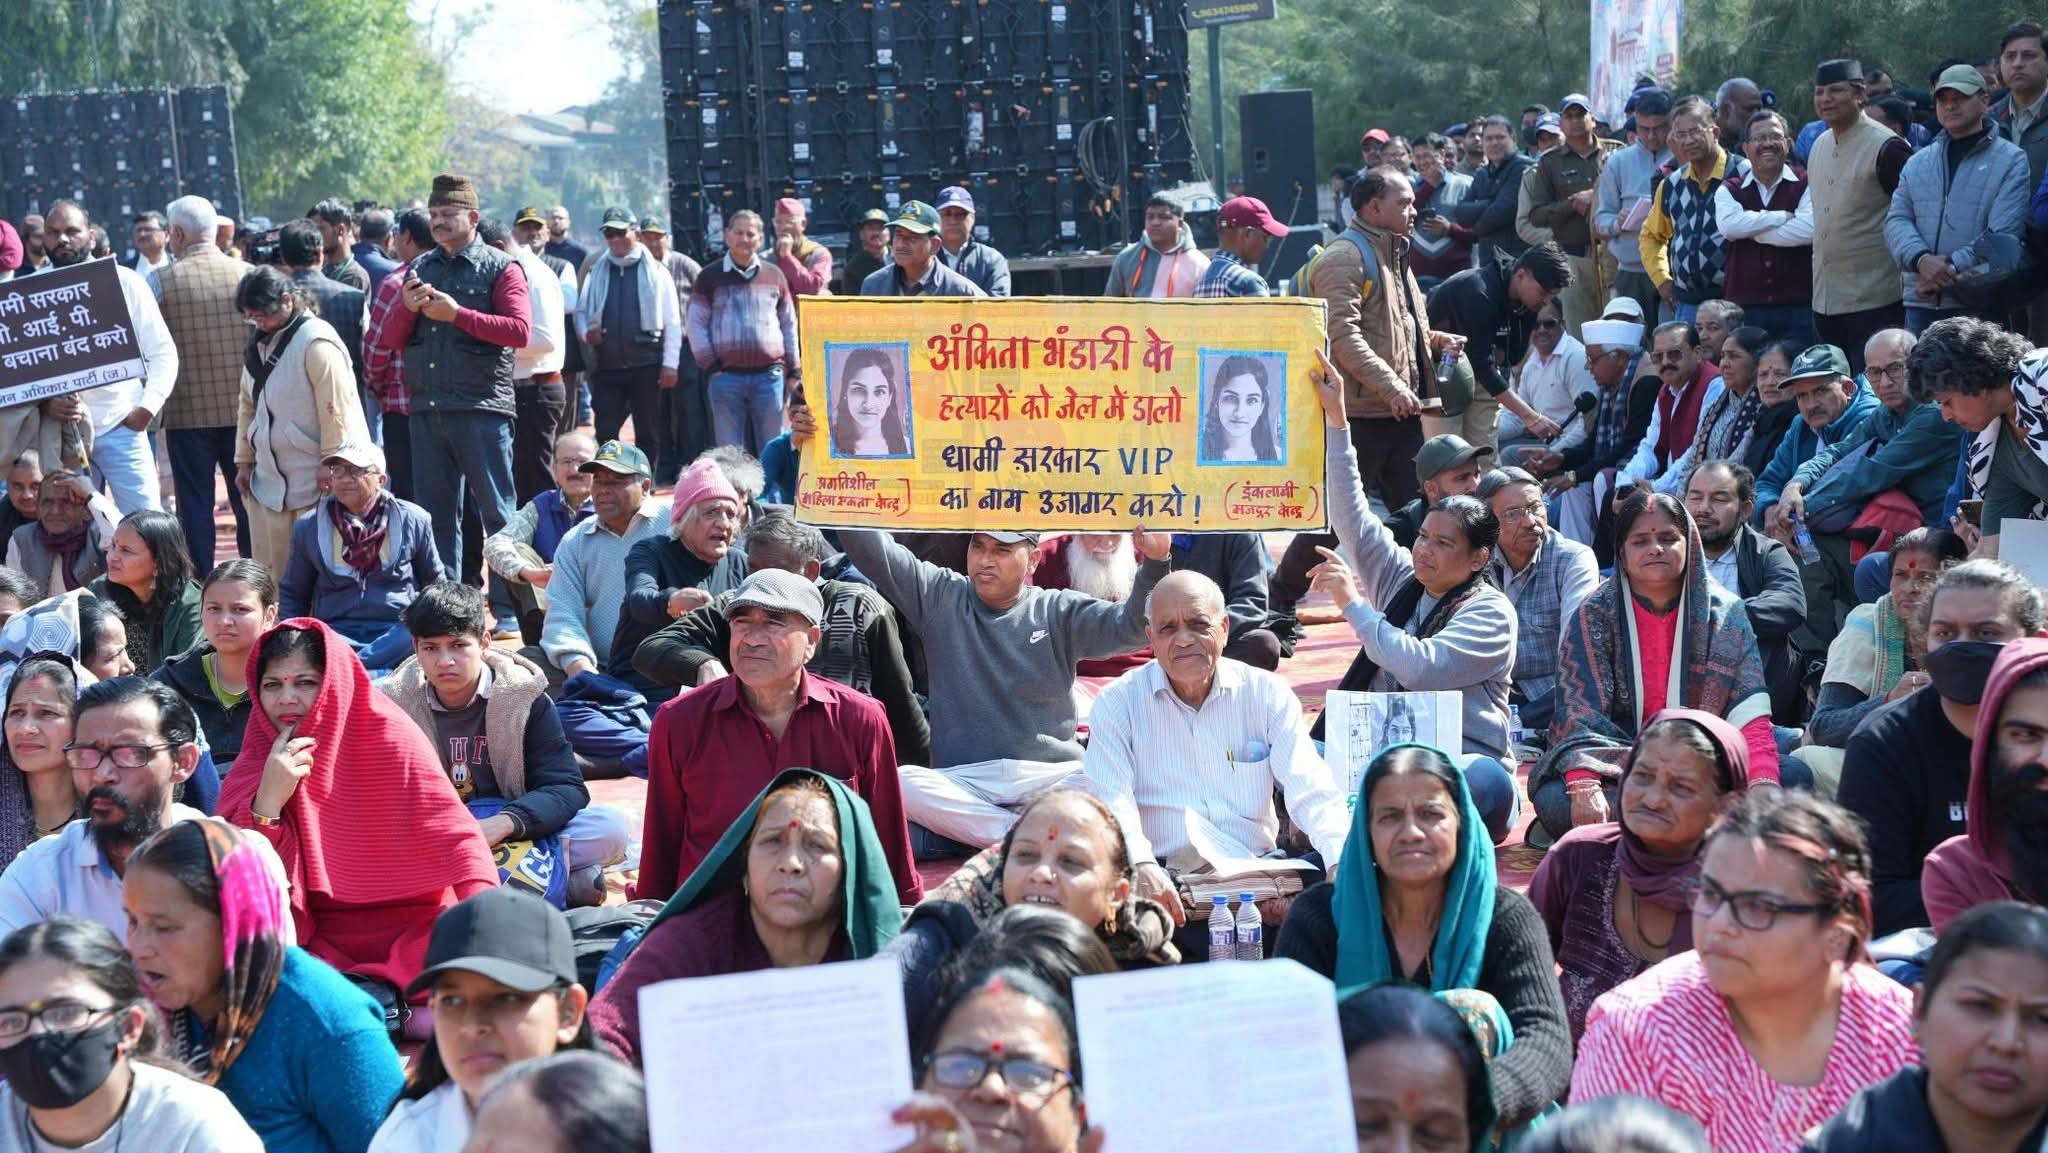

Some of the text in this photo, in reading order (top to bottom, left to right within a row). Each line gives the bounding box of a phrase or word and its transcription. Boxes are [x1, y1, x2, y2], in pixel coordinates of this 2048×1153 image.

[28, 281, 91, 309] सरकार
[23, 311, 66, 338] आई.
[69, 305, 97, 328] पी.
[2, 324, 128, 369] बचाना बंद करो
[927, 323, 1174, 373] अंकिता भंडारी के
[21, 381, 69, 400] अधिकार
[73, 370, 98, 388] पार्टी
[939, 383, 1187, 425] हत्यारों को जेल में डालो
[941, 436, 1174, 475] धामी सरकार VIP
[801, 490, 838, 507] महिला
[940, 487, 971, 510] का
[978, 488, 1028, 513] नाम
[1038, 490, 1123, 516] उजागर
[1129, 484, 1187, 518] करो
